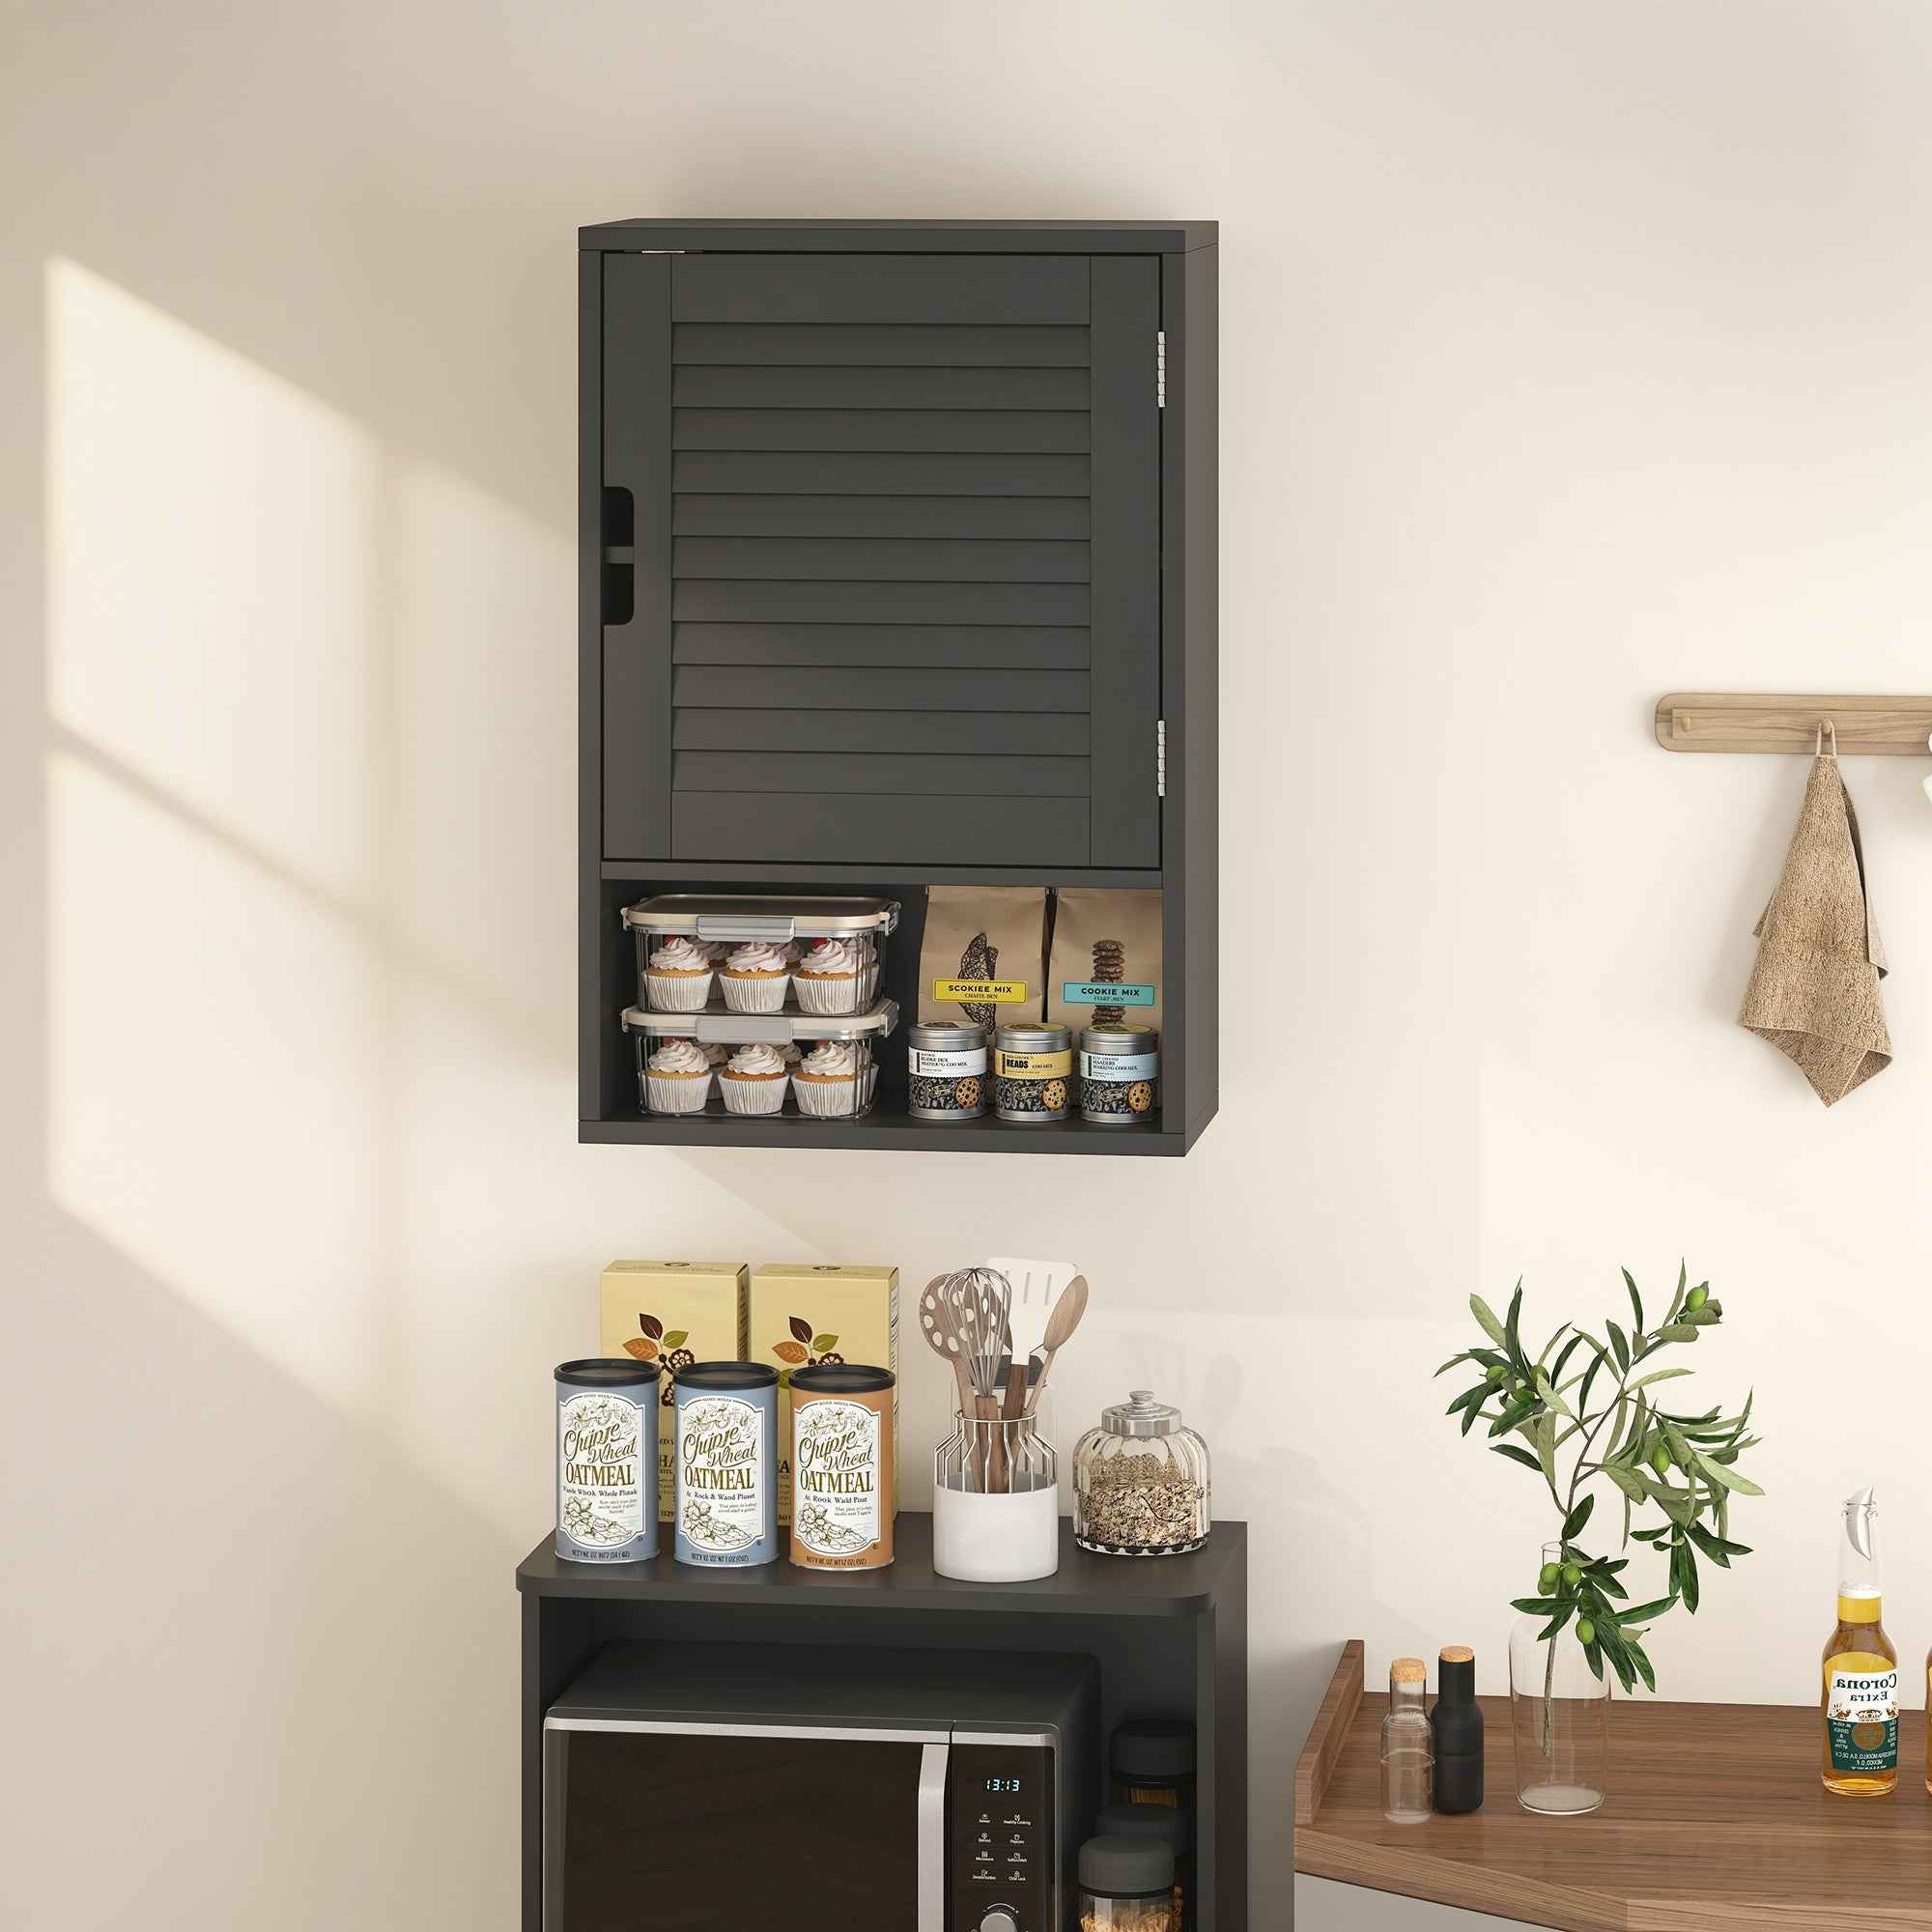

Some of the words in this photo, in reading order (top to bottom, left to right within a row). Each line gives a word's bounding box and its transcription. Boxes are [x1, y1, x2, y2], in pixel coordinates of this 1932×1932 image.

[949, 984, 990, 993] SCOKIEE
[994, 985, 1012, 994] MIX
[1081, 987, 1117, 996] COOKIE
[1122, 988, 1140, 997] MIX
[587, 1435, 638, 1464] Wheat
[707, 1438, 757, 1468] Wheat
[823, 1443, 874, 1472] Wheat
[566, 1462, 635, 1487] OATMEAL
[685, 1465, 754, 1491] OATMEAL
[800, 1469, 874, 1493] OATMEAL
[986, 1778, 1020, 1792] 13:13
